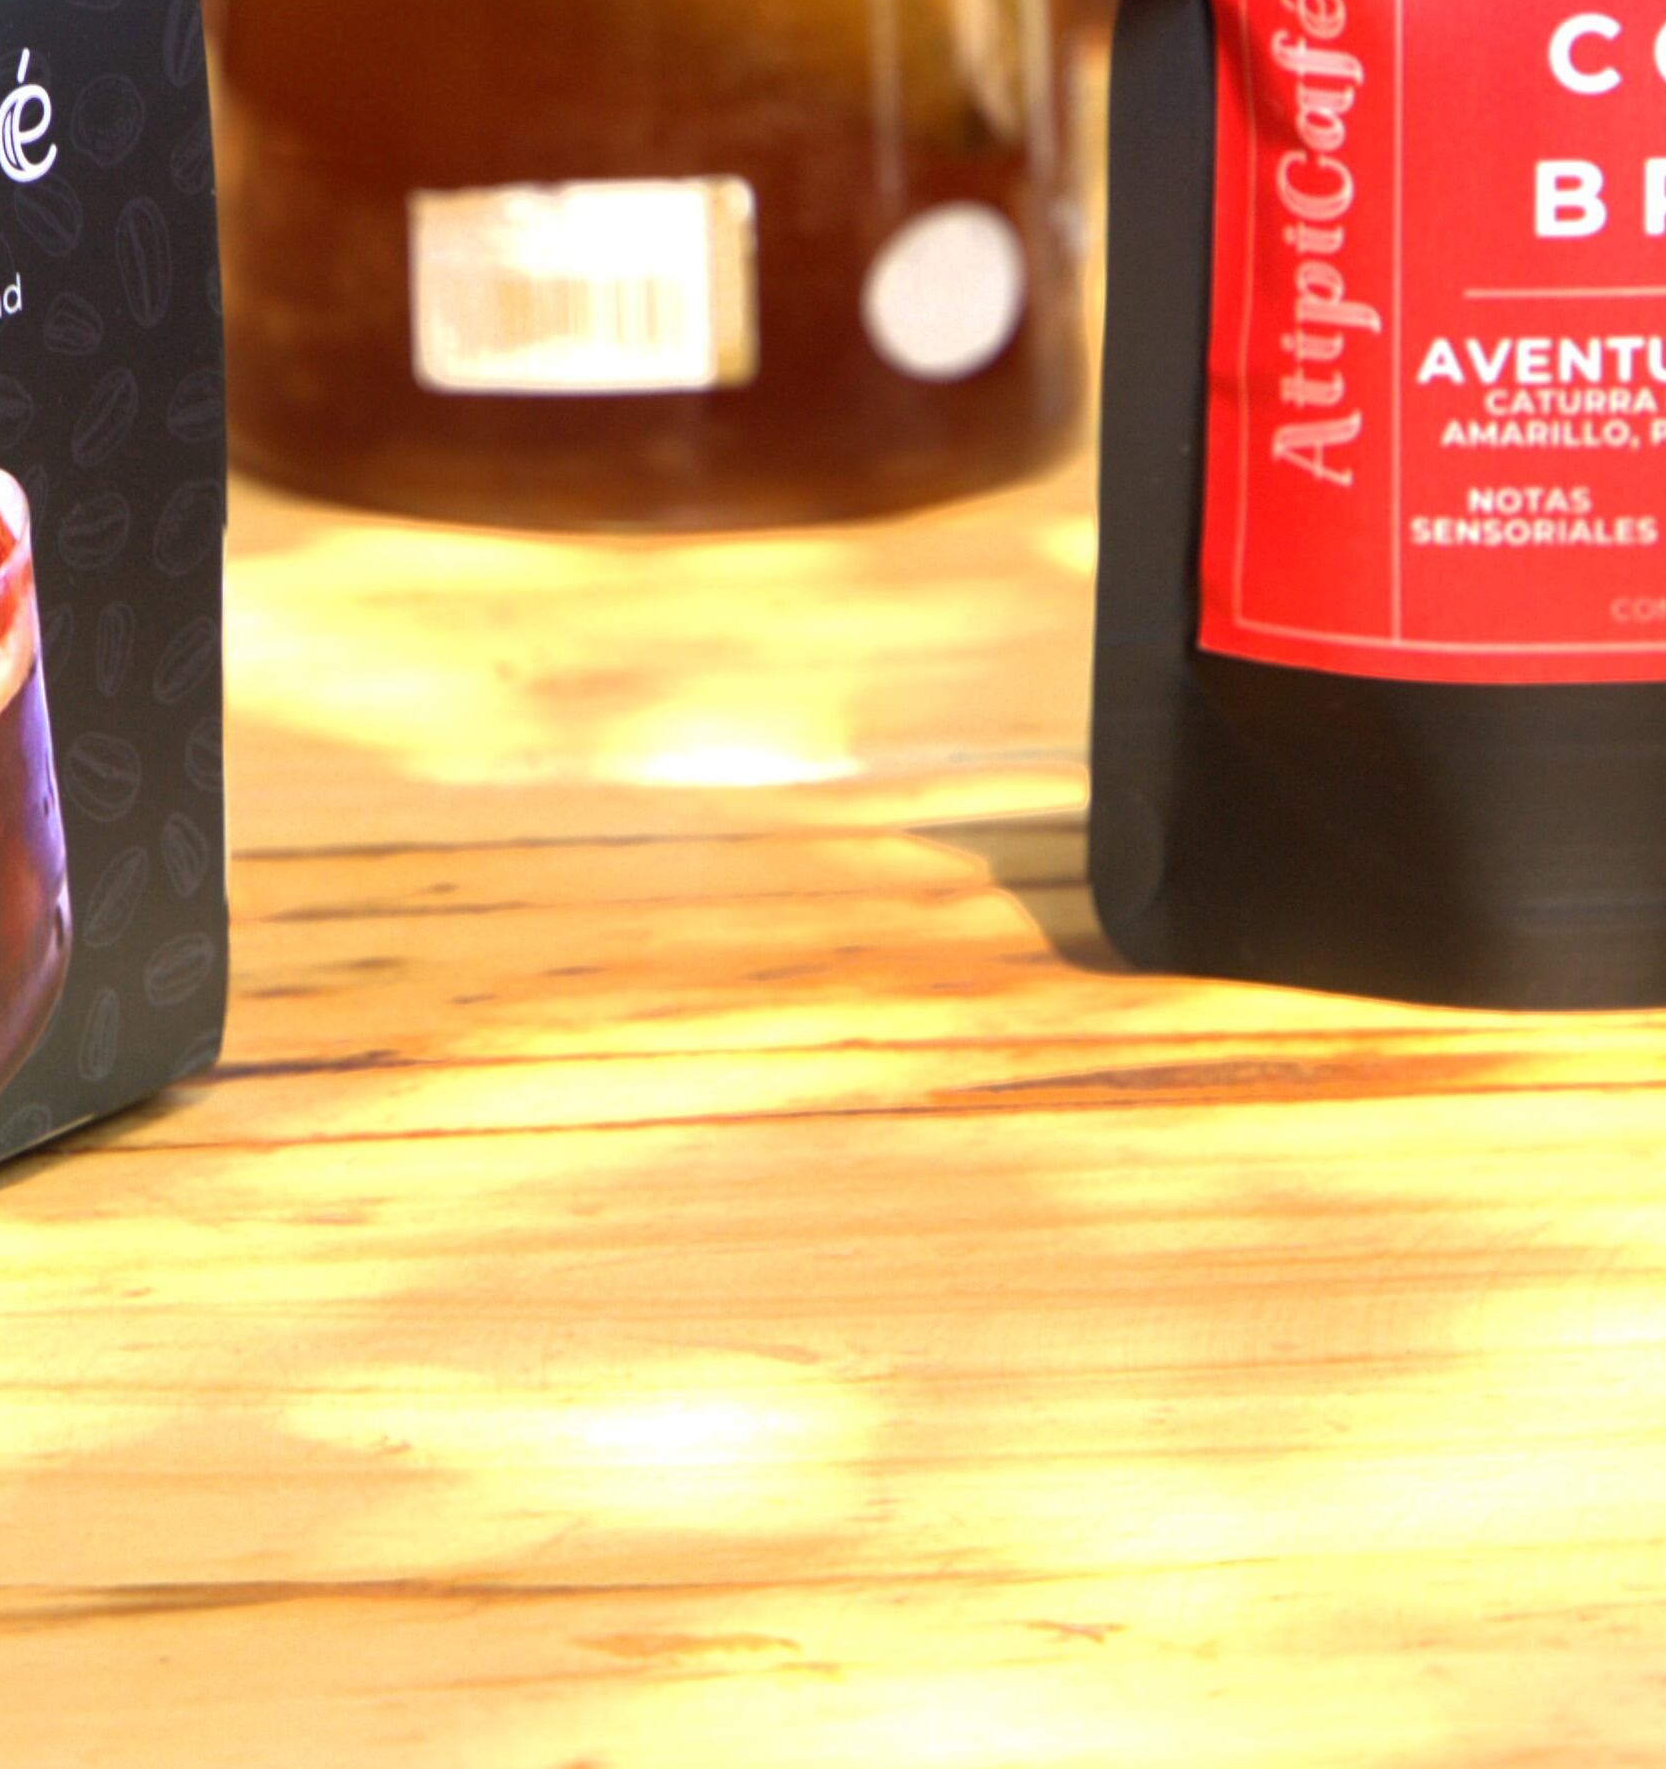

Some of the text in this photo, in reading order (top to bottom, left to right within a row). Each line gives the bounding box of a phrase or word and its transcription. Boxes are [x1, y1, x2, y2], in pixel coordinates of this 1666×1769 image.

[1483, 386, 1658, 416] CATURRA
[1441, 418, 1640, 451] AMARILLO,
[1467, 486, 1592, 514] NOTAS
[1410, 516, 1659, 547] SENSORIALES
